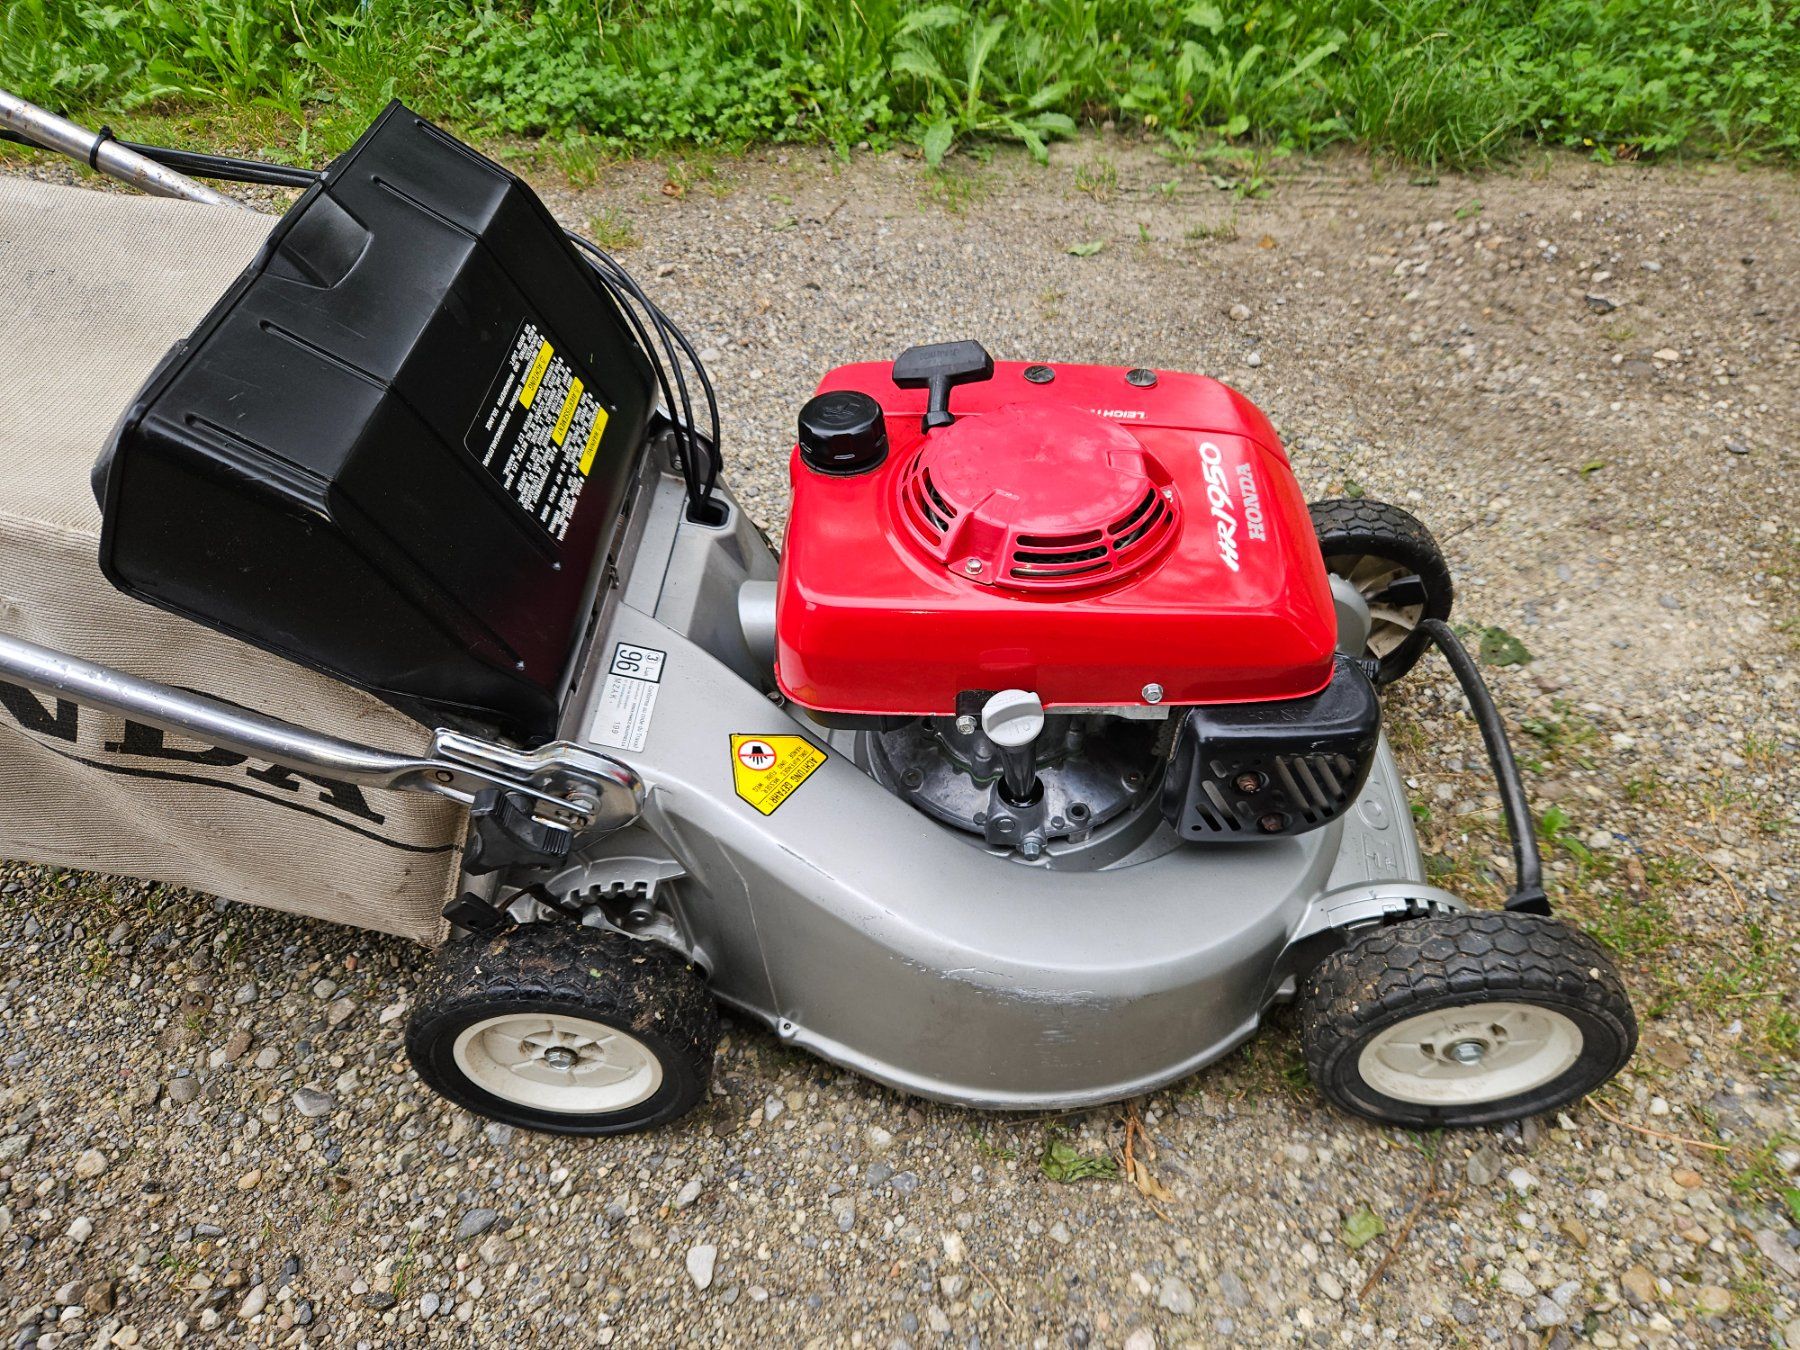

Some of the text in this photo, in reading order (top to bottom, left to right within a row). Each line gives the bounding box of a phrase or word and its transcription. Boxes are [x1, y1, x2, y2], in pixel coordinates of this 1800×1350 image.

[527, 363, 542, 390] ACHTUNG
[556, 393, 576, 435] AVERTISSEMENT
[586, 431, 598, 457] WARNING
[1198, 442, 1240, 573] HR1950
[1236, 461, 1266, 542] HONDA
[615, 649, 643, 672] 96
[790, 757, 818, 783] ACHTUNG
[753, 783, 763, 792] WEG
[761, 777, 780, 794] MESSER
